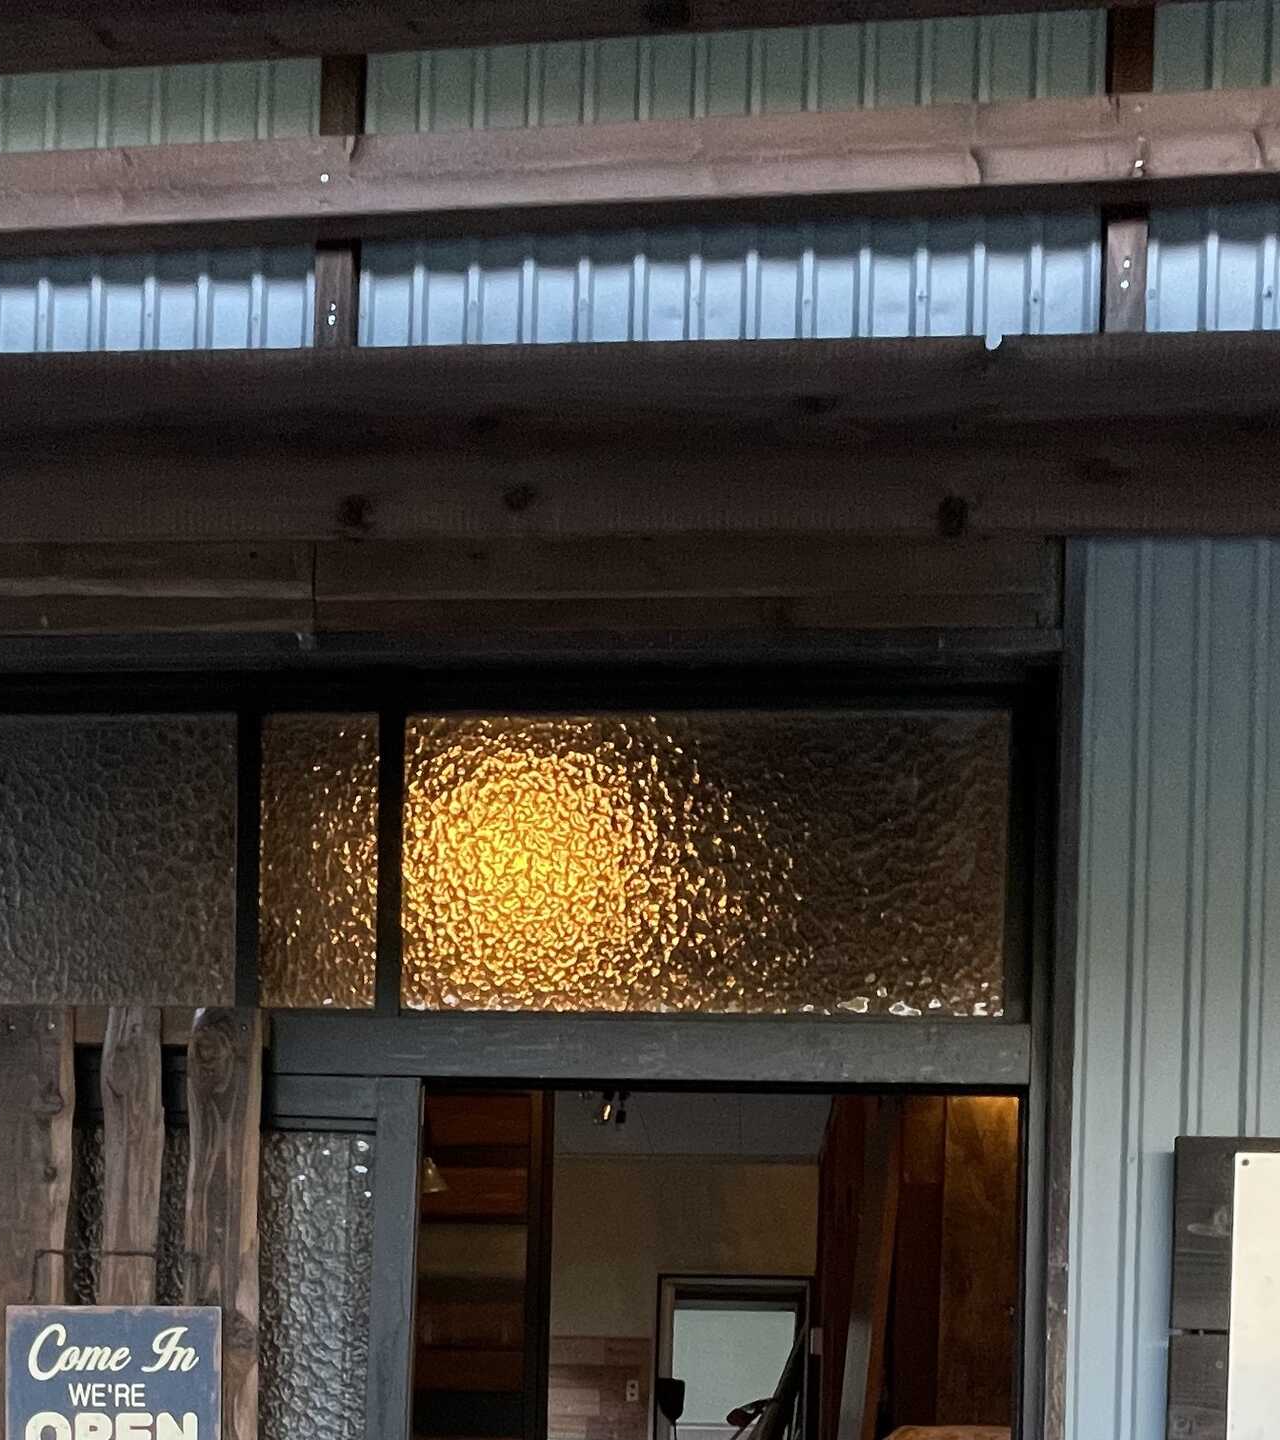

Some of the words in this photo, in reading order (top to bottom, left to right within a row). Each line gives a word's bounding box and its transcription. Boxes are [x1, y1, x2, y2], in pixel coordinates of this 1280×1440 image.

[27, 1323, 132, 1381] Come
[140, 1326, 200, 1373] In
[68, 1382, 146, 1408] WE'RE
